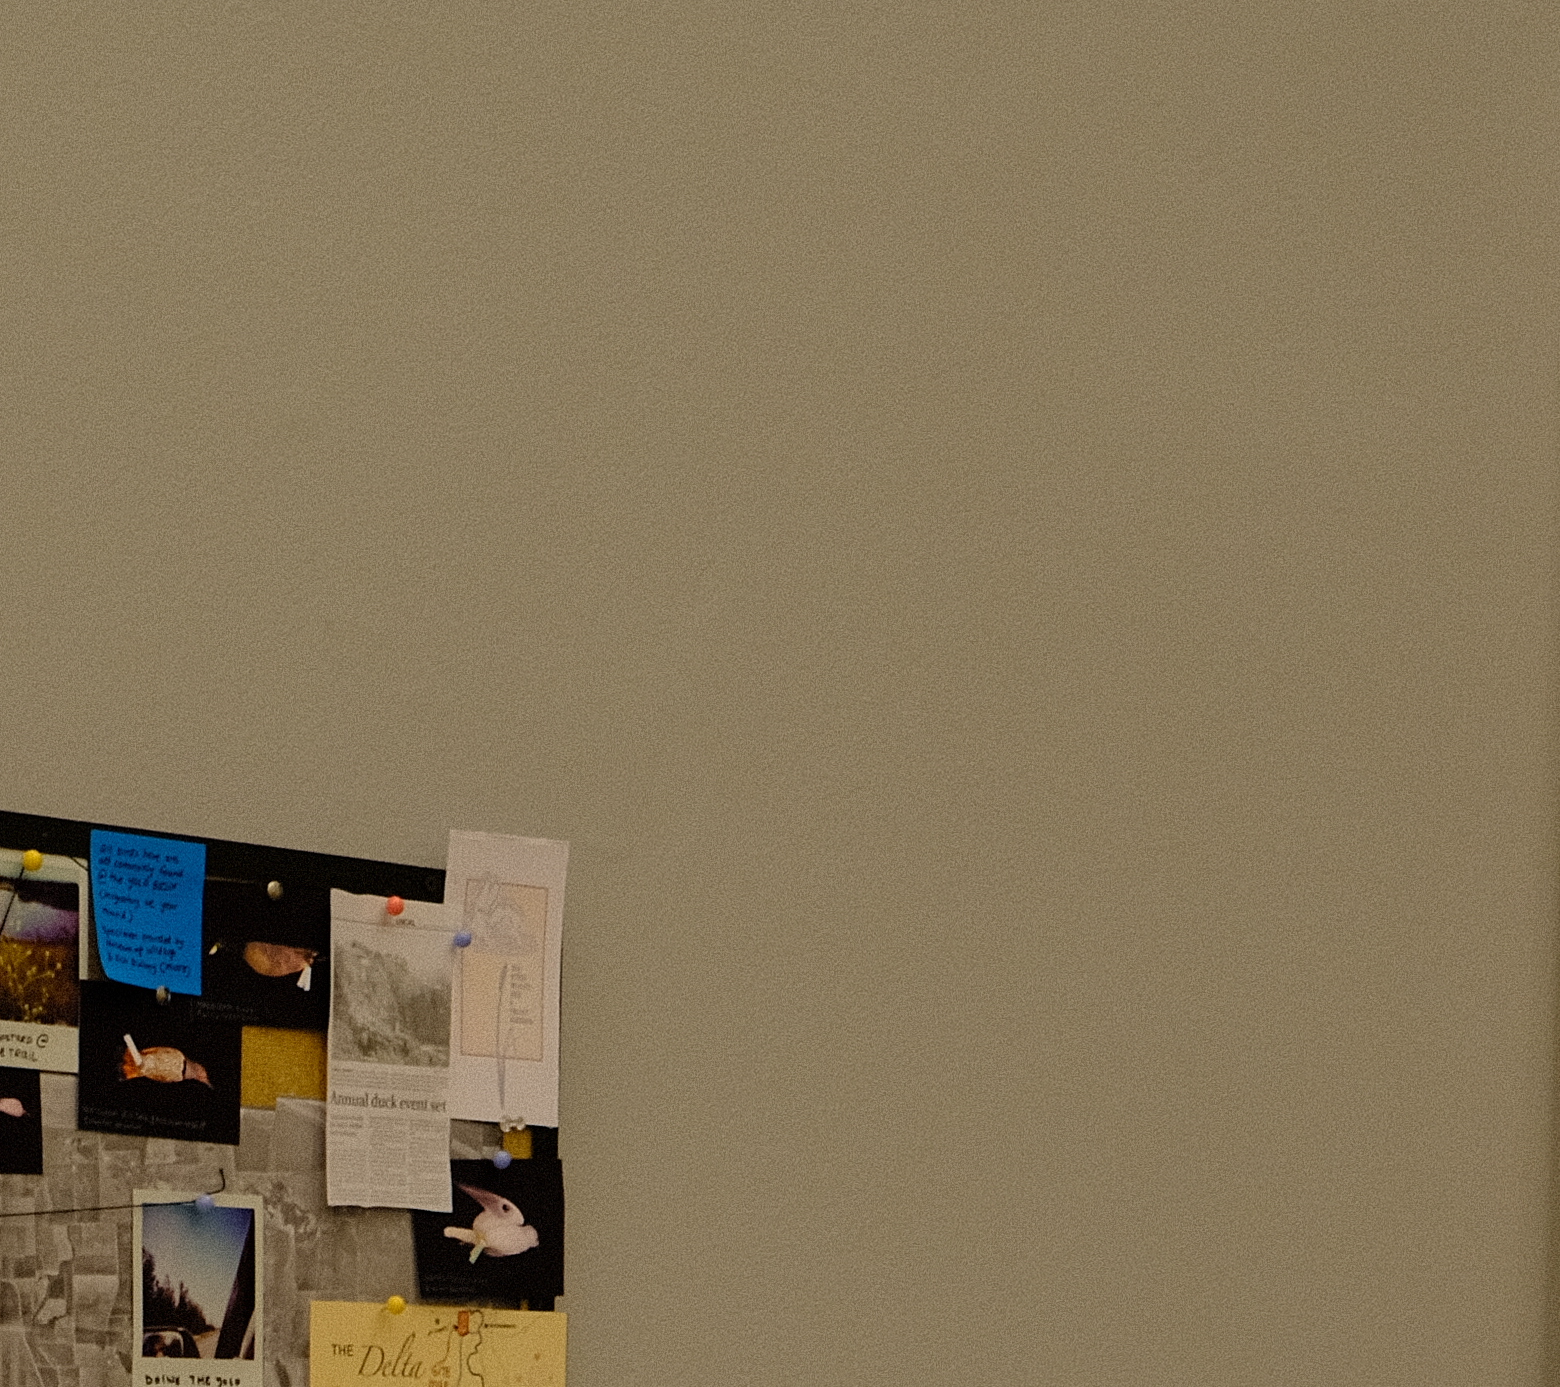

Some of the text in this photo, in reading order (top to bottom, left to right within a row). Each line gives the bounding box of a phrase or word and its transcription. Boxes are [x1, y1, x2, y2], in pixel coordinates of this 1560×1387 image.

[330, 1090, 368, 1107] Annual
[371, 1093, 396, 1109] duck
[399, 1100, 427, 1111] event
[332, 1331, 427, 1378] THE Delta
